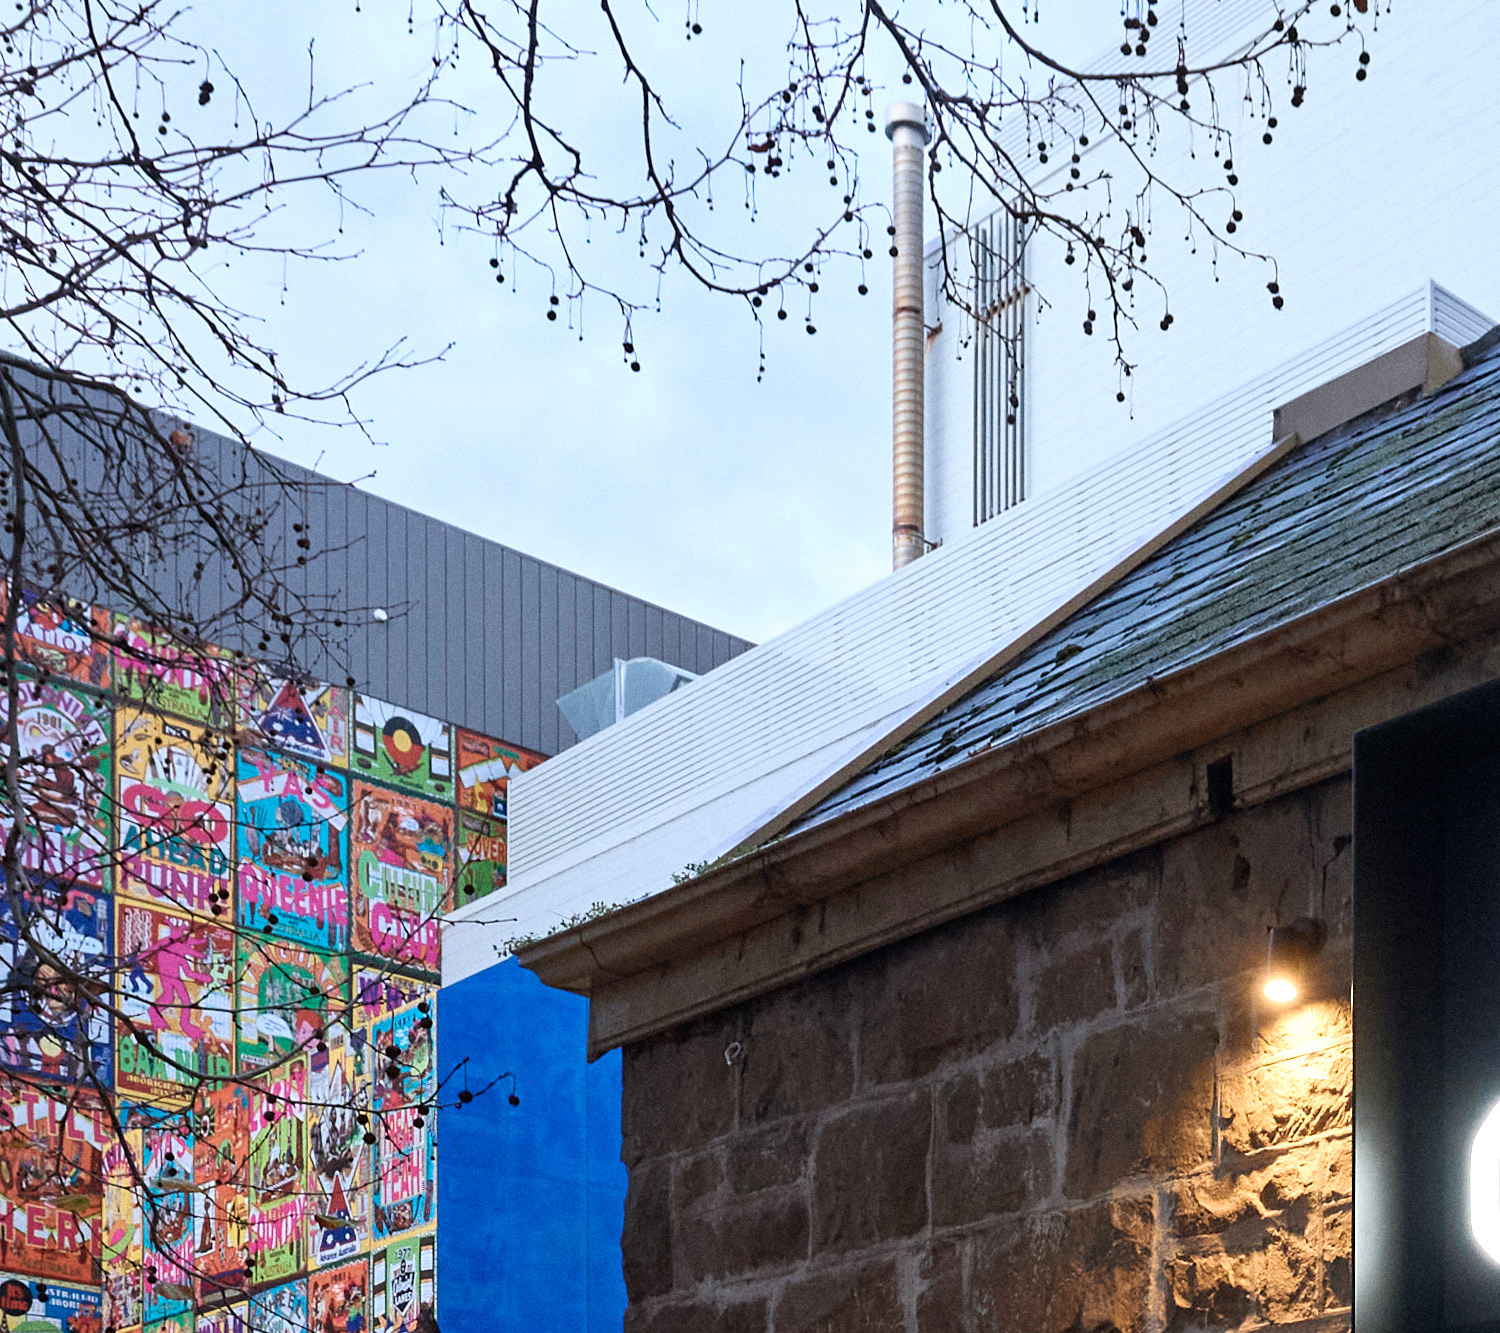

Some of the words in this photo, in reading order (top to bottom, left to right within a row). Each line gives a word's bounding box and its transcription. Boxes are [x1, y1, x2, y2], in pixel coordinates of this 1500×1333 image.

[35, 711, 62, 729] 1981
[329, 688, 347, 748] FAIR
[253, 759, 332, 810] YAS
[238, 863, 350, 927] QUEENIE
